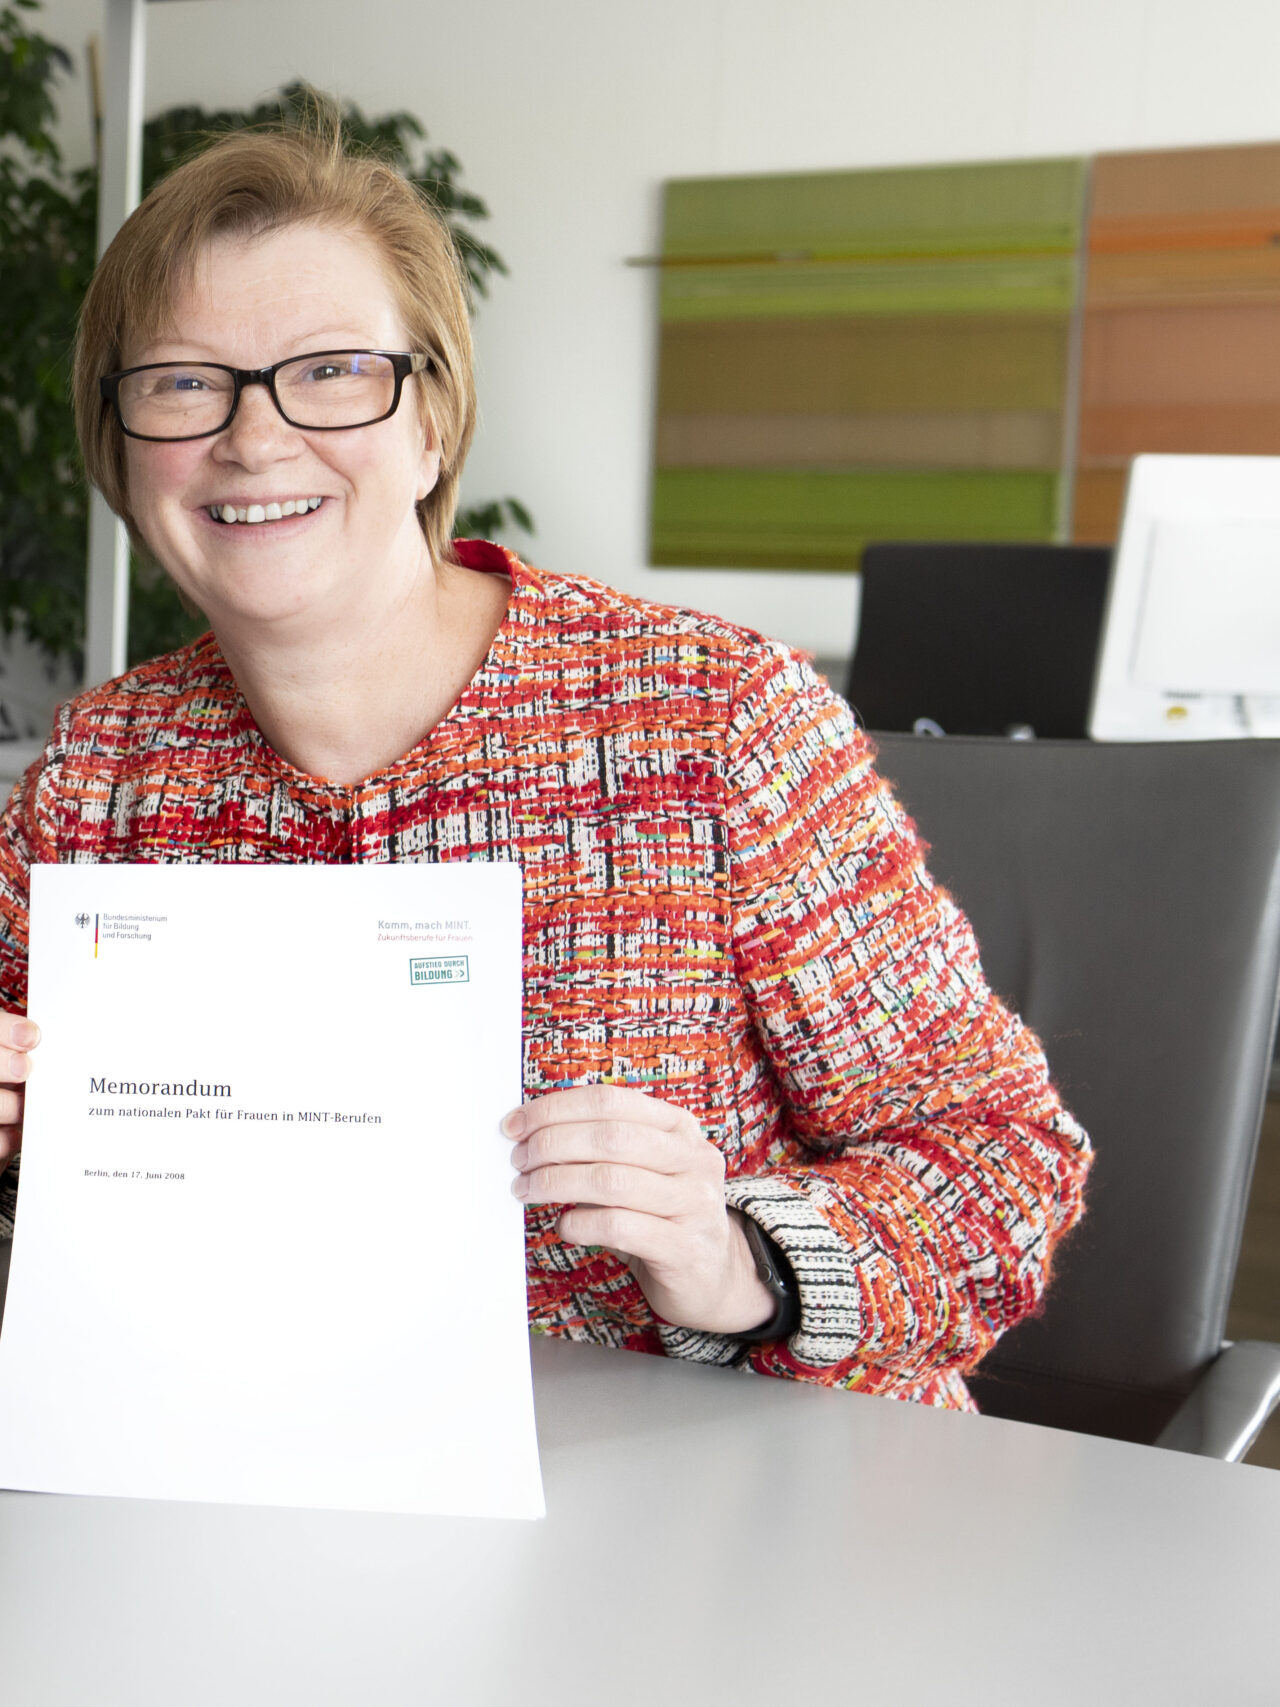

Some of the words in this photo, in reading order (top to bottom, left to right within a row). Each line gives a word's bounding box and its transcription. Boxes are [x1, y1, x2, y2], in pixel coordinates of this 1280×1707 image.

[103, 913, 168, 922] Bundesministerium
[114, 923, 140, 932] Bildung
[377, 920, 412, 930] Komm,
[415, 920, 442, 930] mach
[445, 920, 472, 930] MINT.
[117, 932, 152, 941] Forschung
[377, 933, 434, 942] Zukunftsberufe
[436, 933, 446, 942] für
[448, 933, 474, 942] Frauen
[414, 961, 442, 969] AUFSTIEG
[444, 960, 465, 968] DURCH
[414, 970, 453, 981] BILDUNG
[90, 1077, 232, 1097] Memorandum
[88, 1107, 115, 1117] zum
[118, 1107, 181, 1119] nationalen
[186, 1108, 211, 1119] Pakt
[215, 1109, 234, 1120] für
[237, 1109, 278, 1121] Frauen
[282, 1111, 294, 1122] in
[298, 1111, 382, 1124] MINT-Berufen
[84, 1169, 111, 1178] Berlin,
[112, 1170, 128, 1178] den
[131, 1171, 143, 1179] 17.
[145, 1171, 163, 1180] Juni
[164, 1172, 186, 1180] 2008
